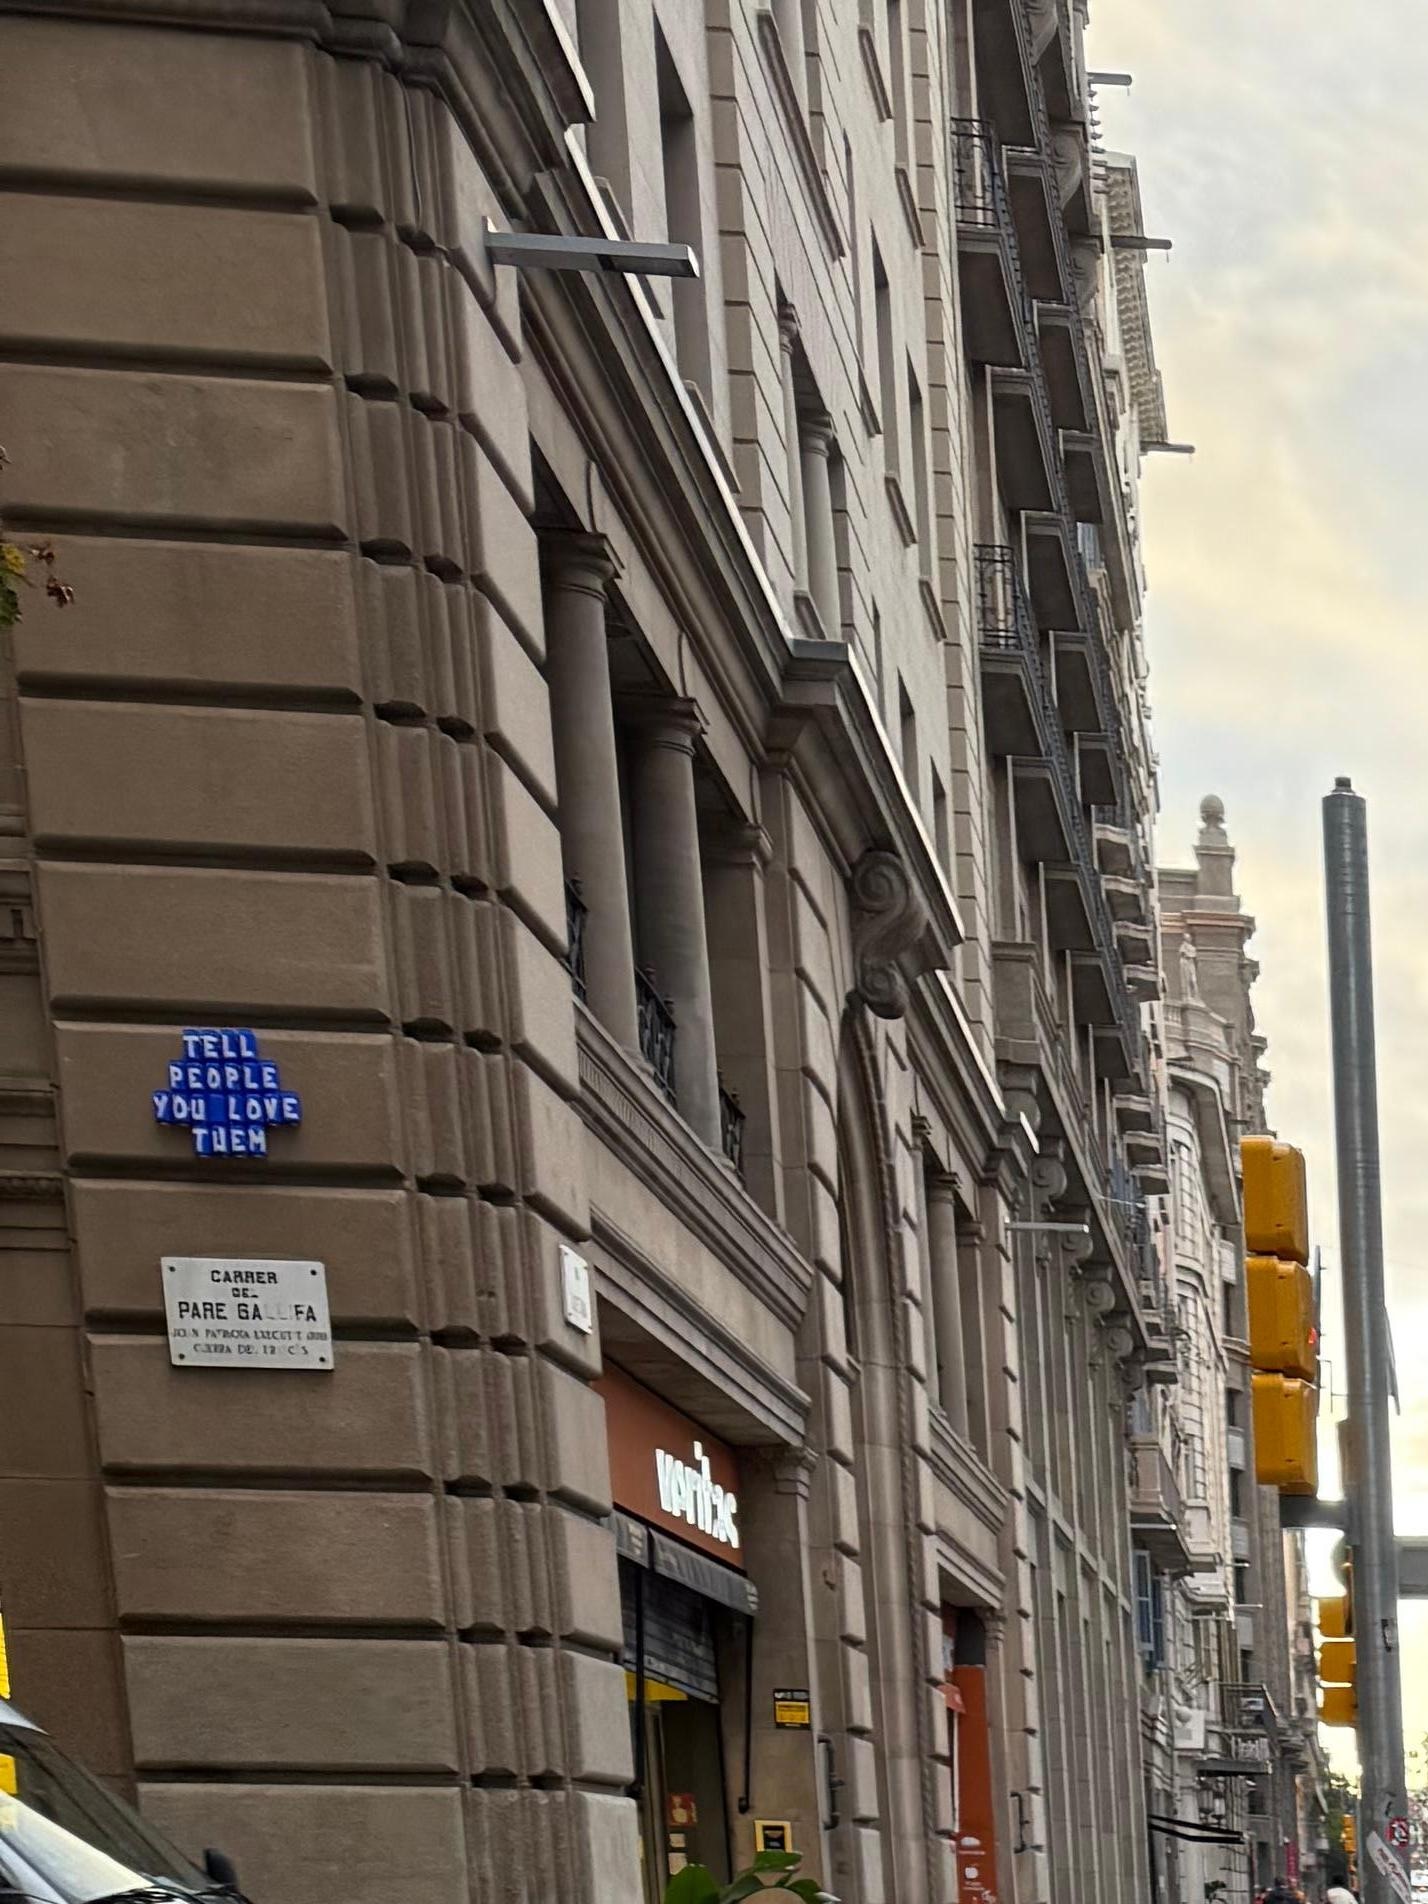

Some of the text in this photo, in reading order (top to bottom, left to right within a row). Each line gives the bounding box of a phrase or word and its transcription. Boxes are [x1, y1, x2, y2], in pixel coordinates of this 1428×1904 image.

[183, 1034, 254, 1058] TELL
[169, 1065, 277, 1089] PEOPLE
[153, 1095, 299, 1120] YOU LOVE
[211, 1270, 278, 1284] CARRER
[178, 1301, 228, 1320] PARE
[655, 1440, 740, 1549] veritas
